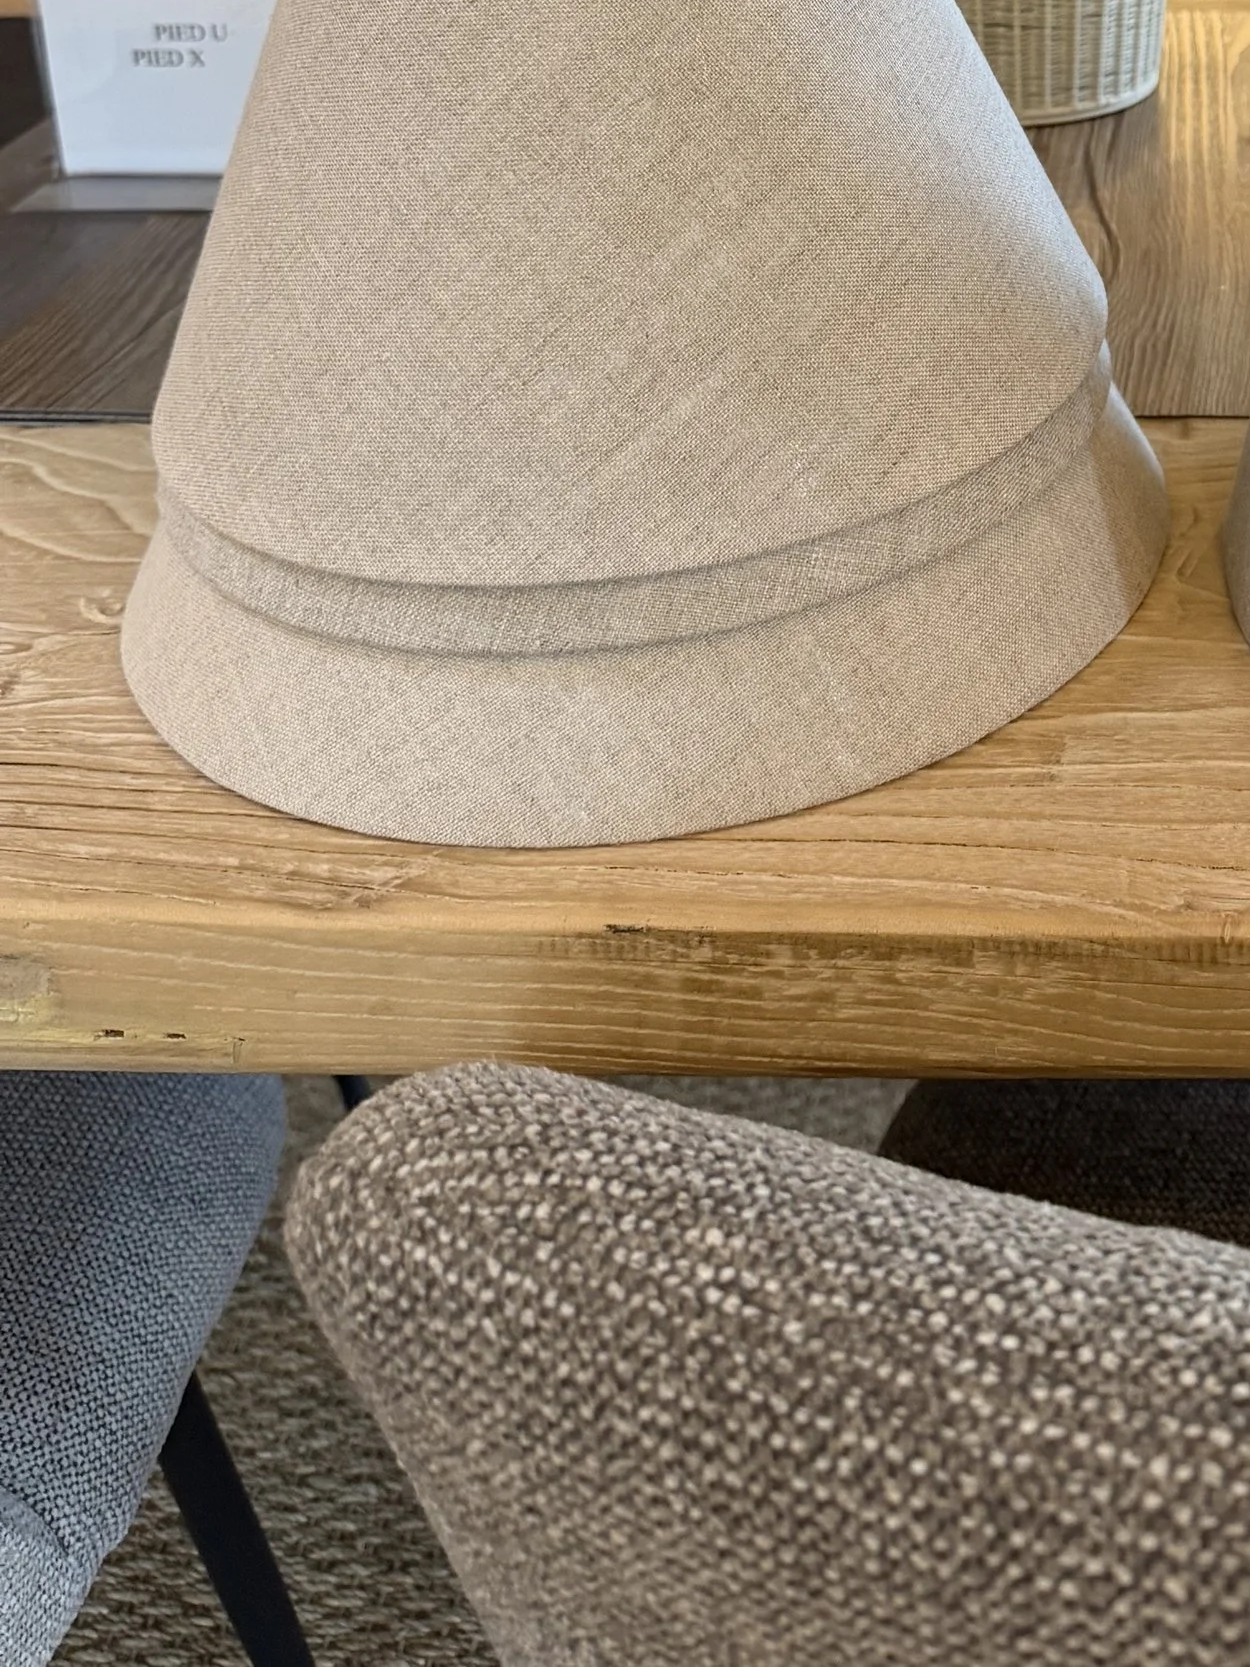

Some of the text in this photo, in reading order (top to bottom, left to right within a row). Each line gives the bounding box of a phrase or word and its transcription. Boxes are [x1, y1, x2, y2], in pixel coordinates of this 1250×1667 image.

[153, 22, 229, 43] PIED U
[131, 48, 206, 68] PIED X
